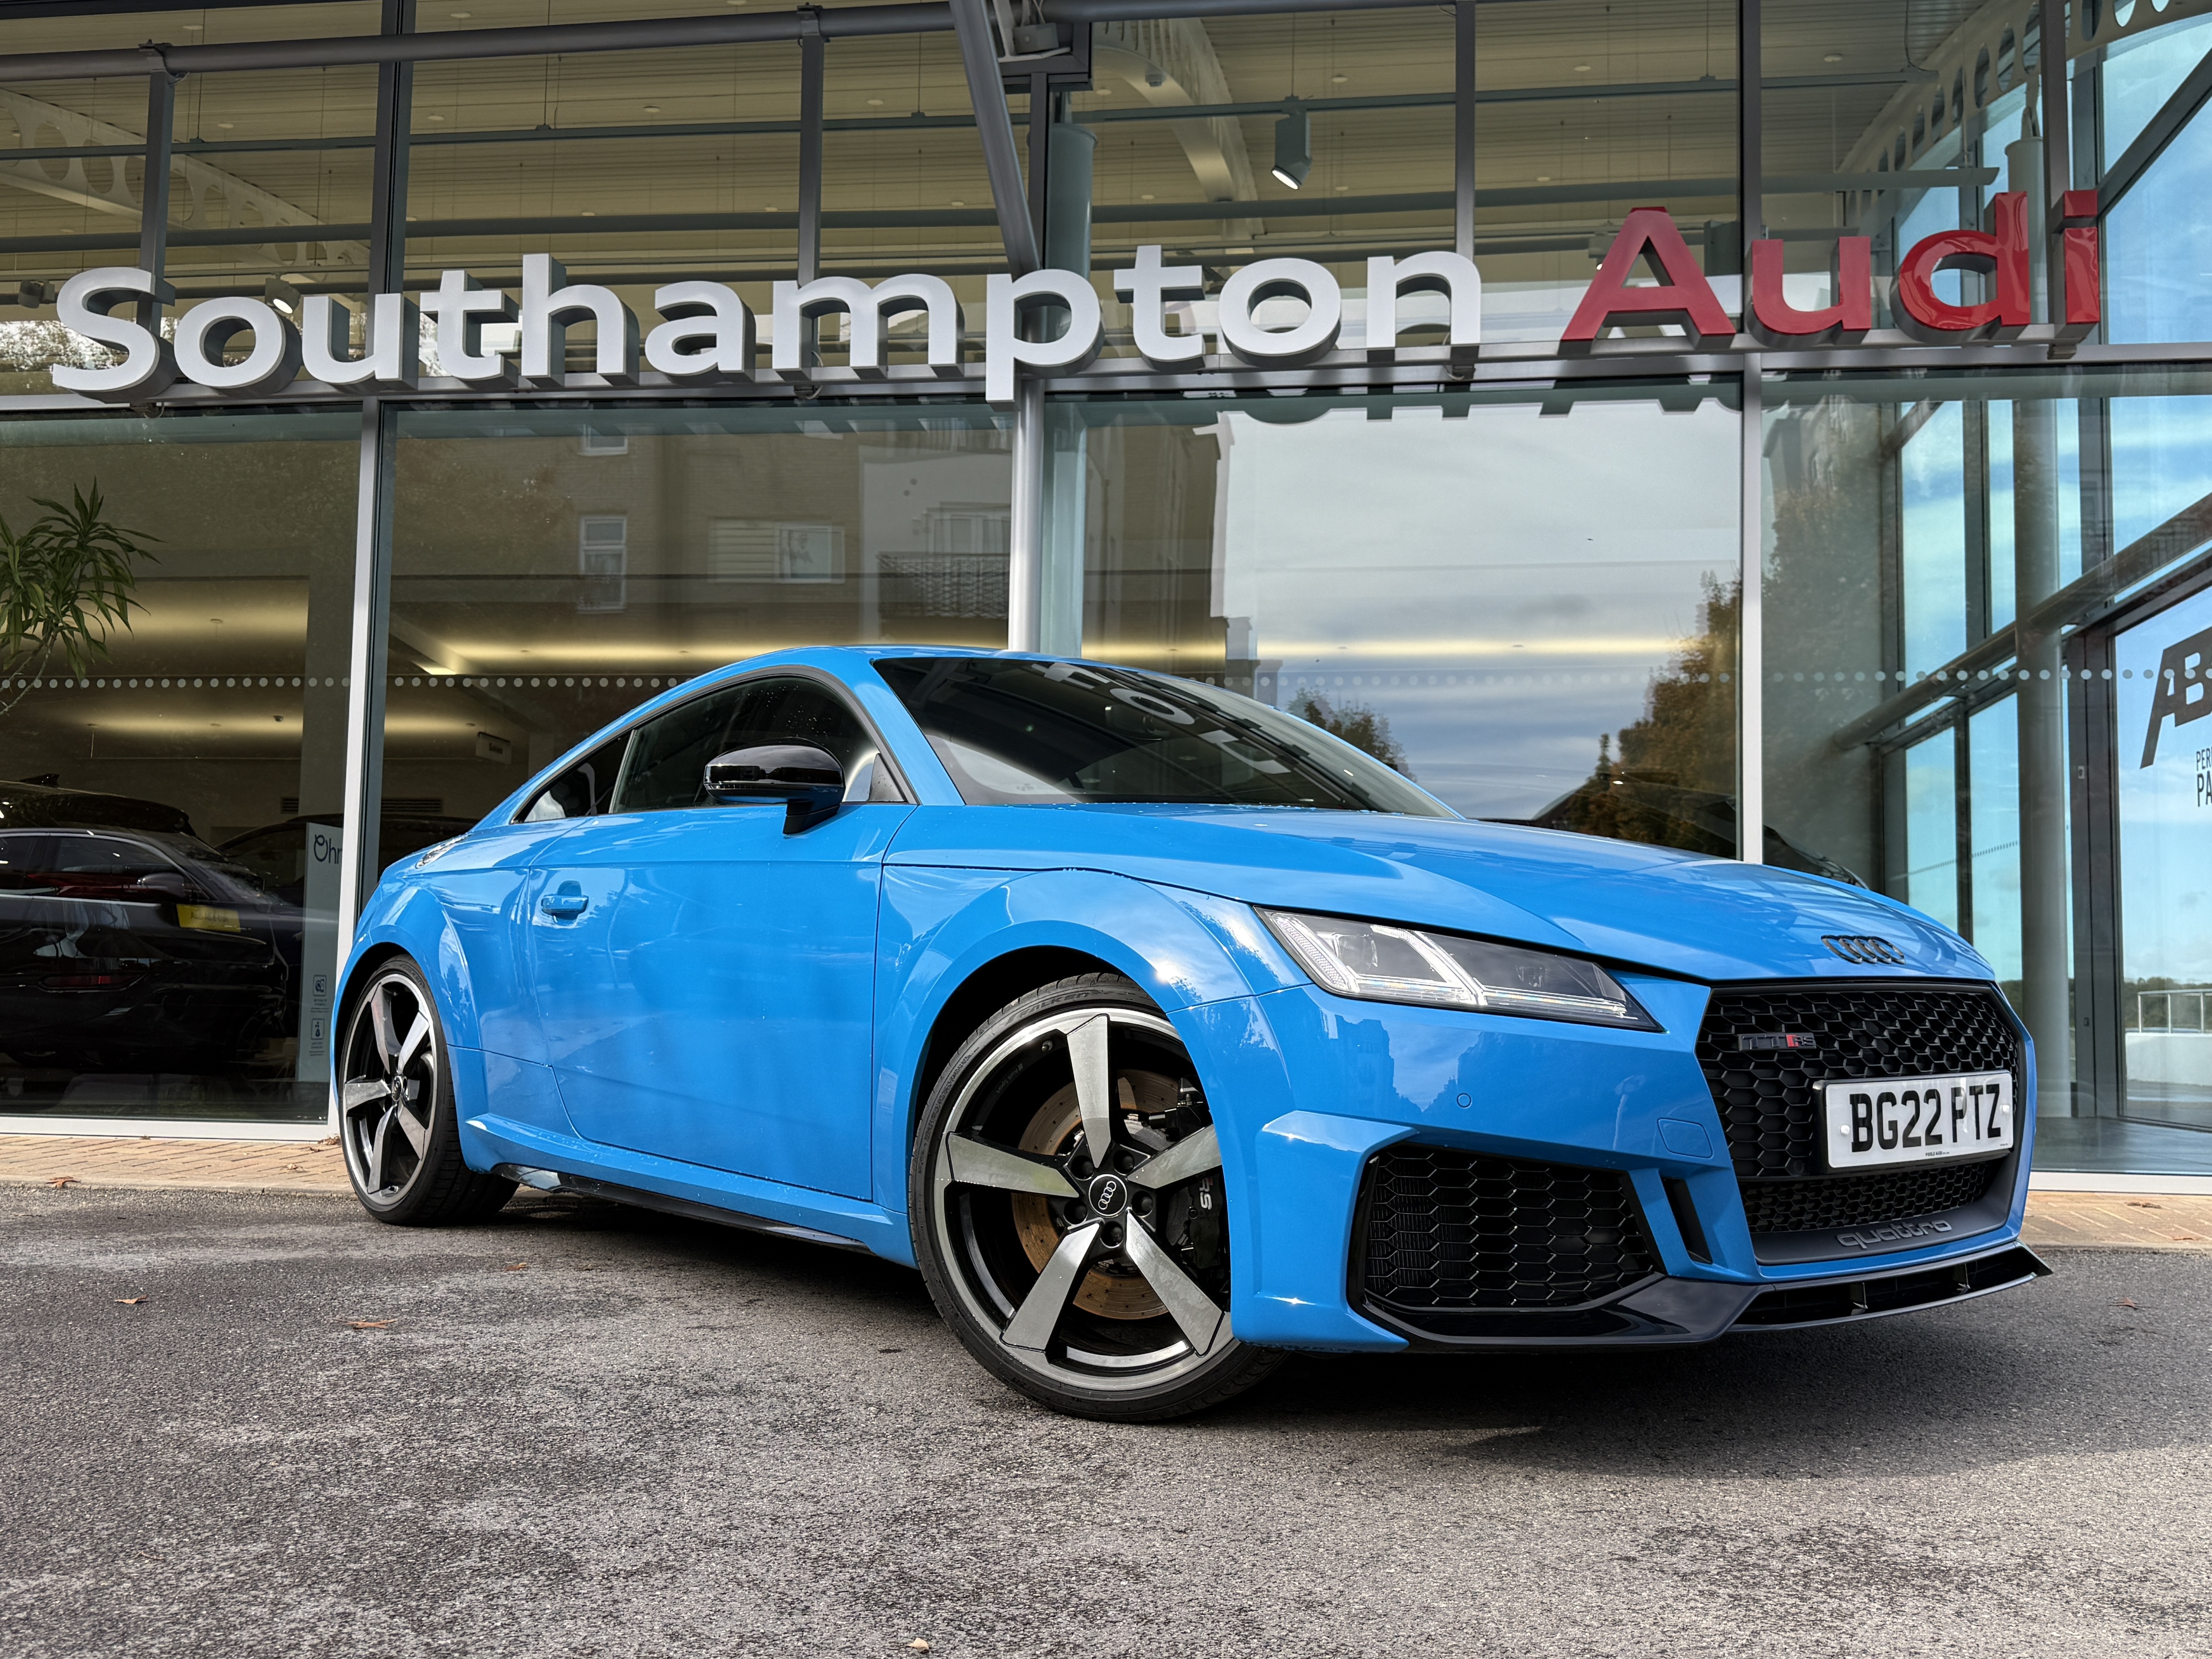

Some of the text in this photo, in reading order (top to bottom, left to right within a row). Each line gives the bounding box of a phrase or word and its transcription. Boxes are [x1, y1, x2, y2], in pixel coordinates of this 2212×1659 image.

[52, 190, 2100, 401] Southampton Audi
[2196, 746, 2212, 771] PER
[1017, 992, 1089, 1018] FALKEN
[1850, 1083, 2001, 1153] BG22 PTZ
[1199, 1177, 1212, 1210] RS
[1836, 1219, 1952, 1249] quattro
